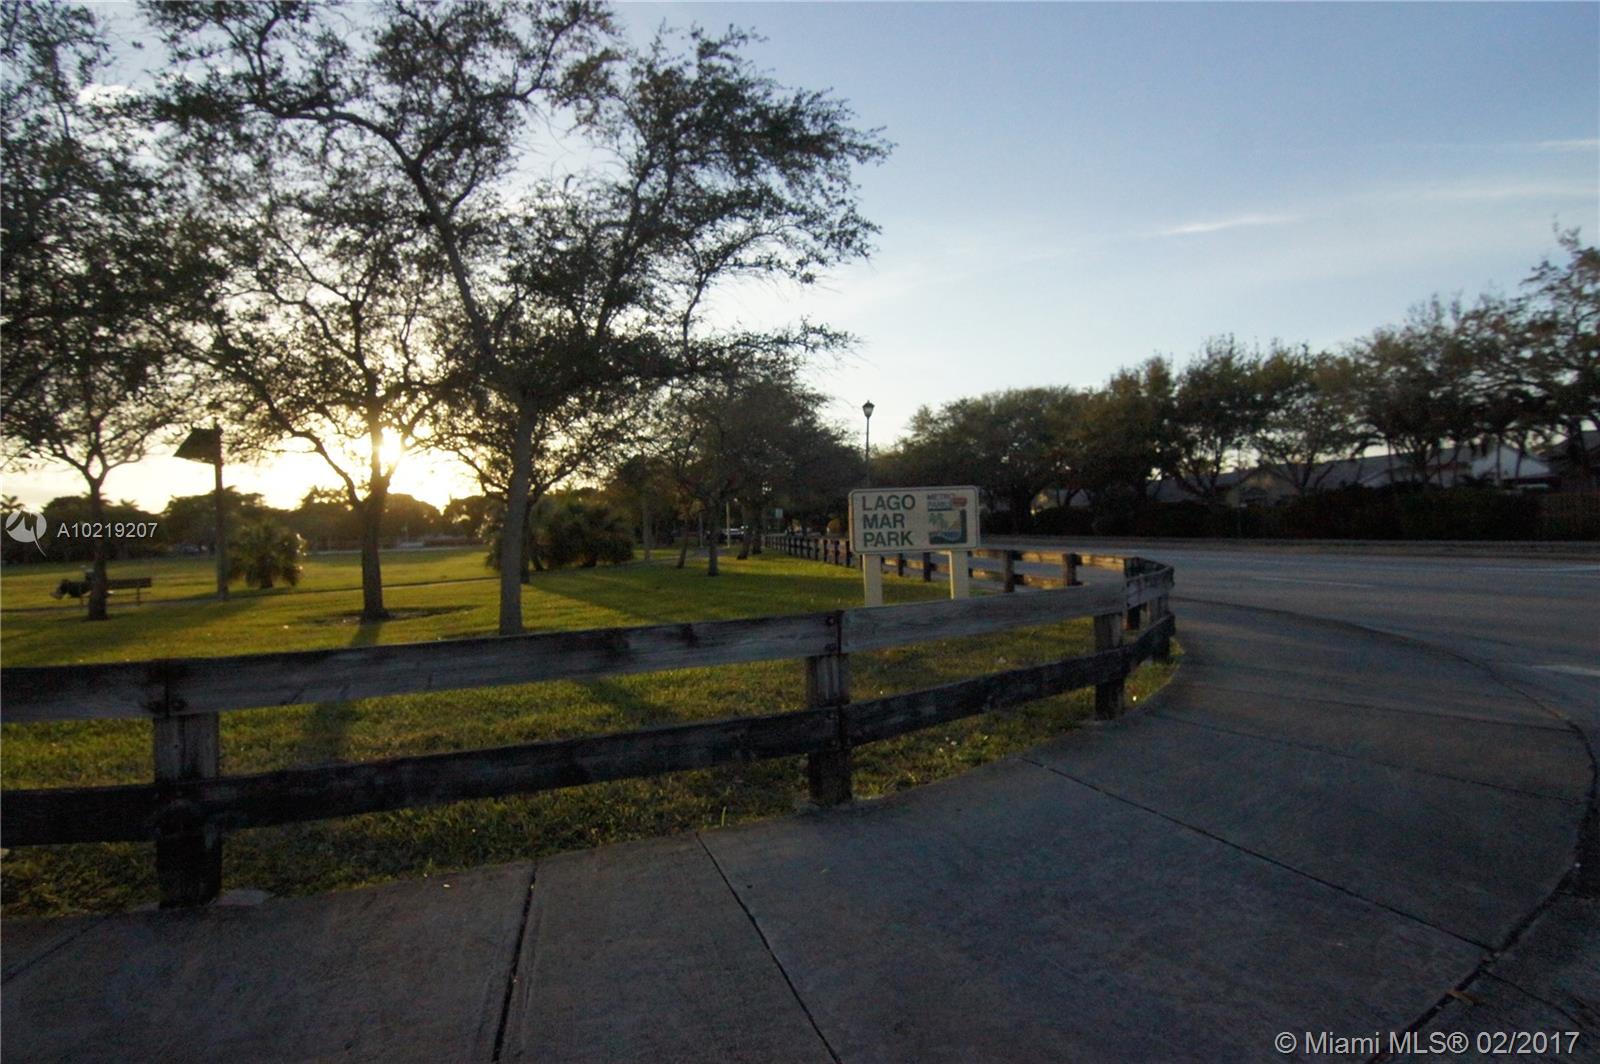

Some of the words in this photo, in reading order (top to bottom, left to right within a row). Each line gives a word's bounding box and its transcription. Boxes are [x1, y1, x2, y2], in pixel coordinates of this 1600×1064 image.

[862, 494, 916, 511] LAGO
[863, 513, 905, 529] MAR
[863, 531, 914, 547] PARK
